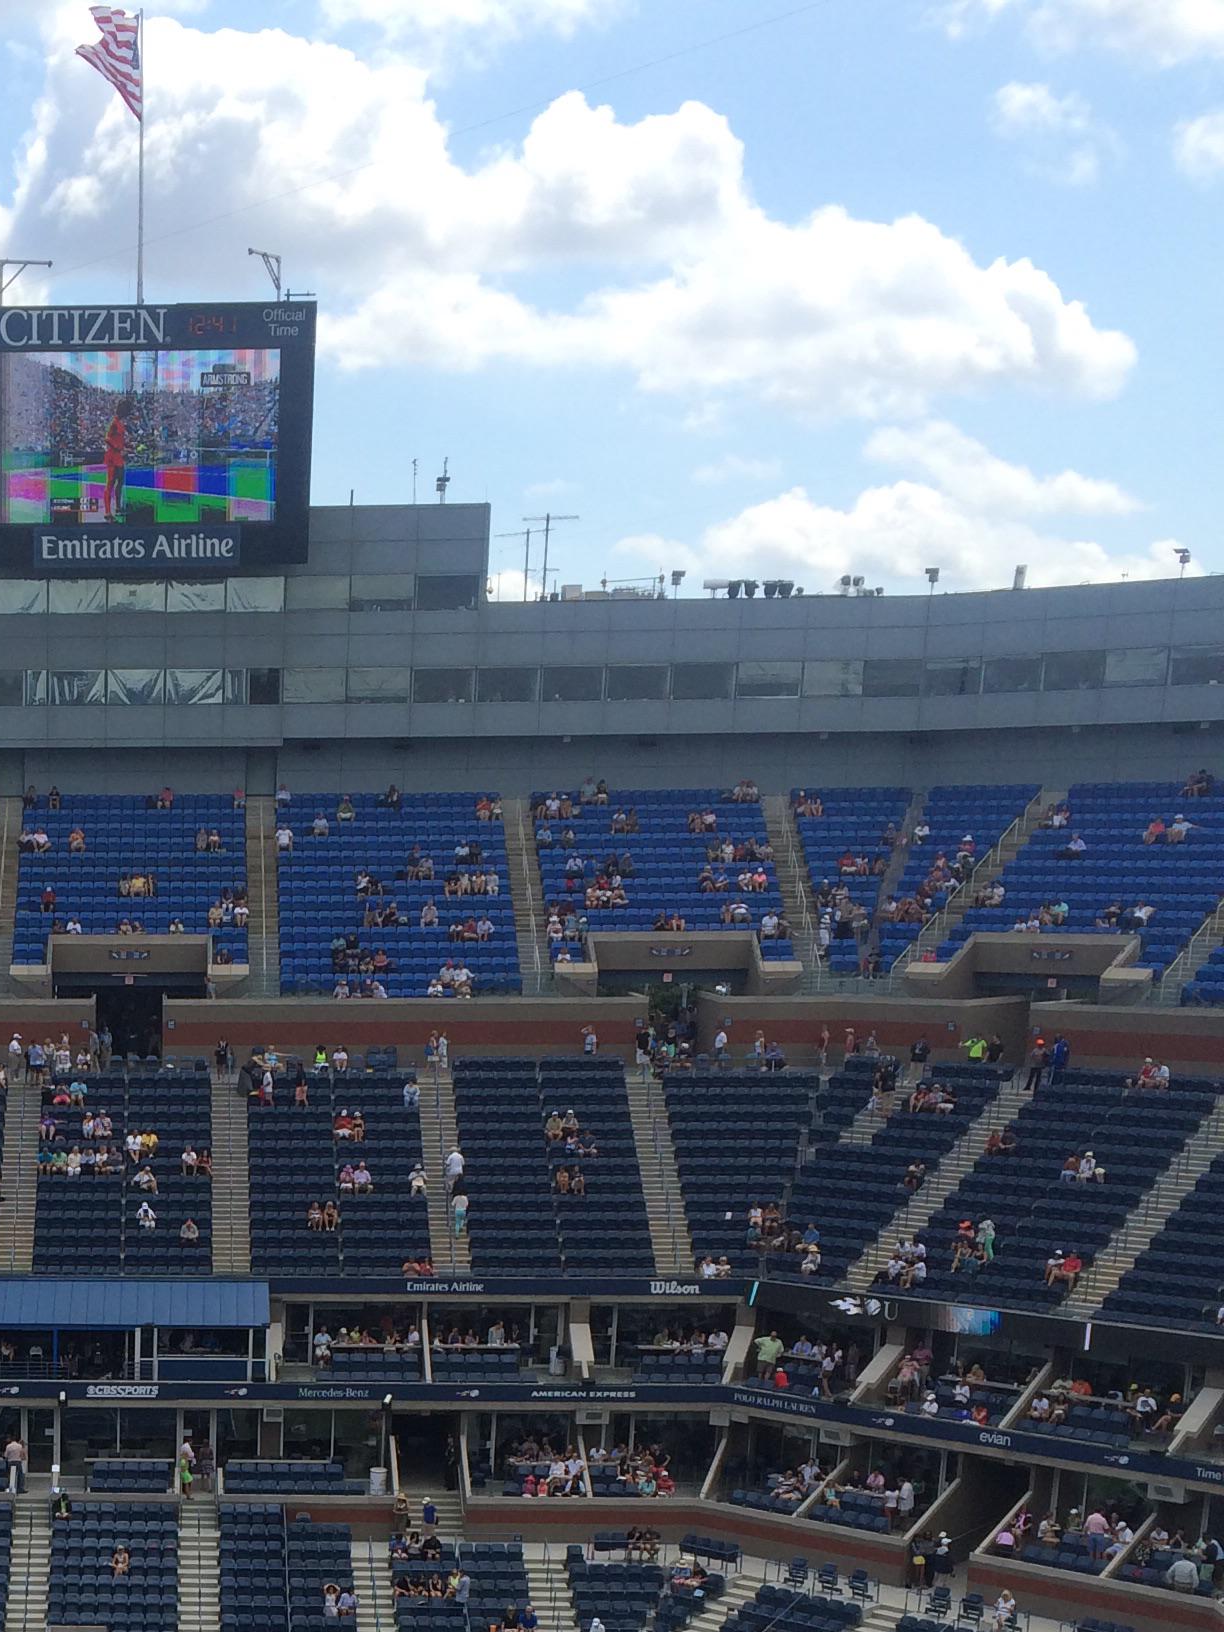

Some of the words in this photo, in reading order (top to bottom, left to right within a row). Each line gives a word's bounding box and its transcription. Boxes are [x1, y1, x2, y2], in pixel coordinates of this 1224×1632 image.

[262, 308, 306, 321] Official
[0, 308, 167, 346] CITIZEN
[268, 323, 299, 336] Time
[41, 534, 146, 559] Emirates
[152, 533, 234, 558] Airline
[406, 1281, 449, 1292] Emirates
[450, 1281, 484, 1292] Airline
[649, 1280, 701, 1294] Wilson
[298, 1387, 369, 1398] Mercedes-Benz
[531, 1390, 587, 1398] AMERICAN
[979, 1431, 1011, 1447] evian
